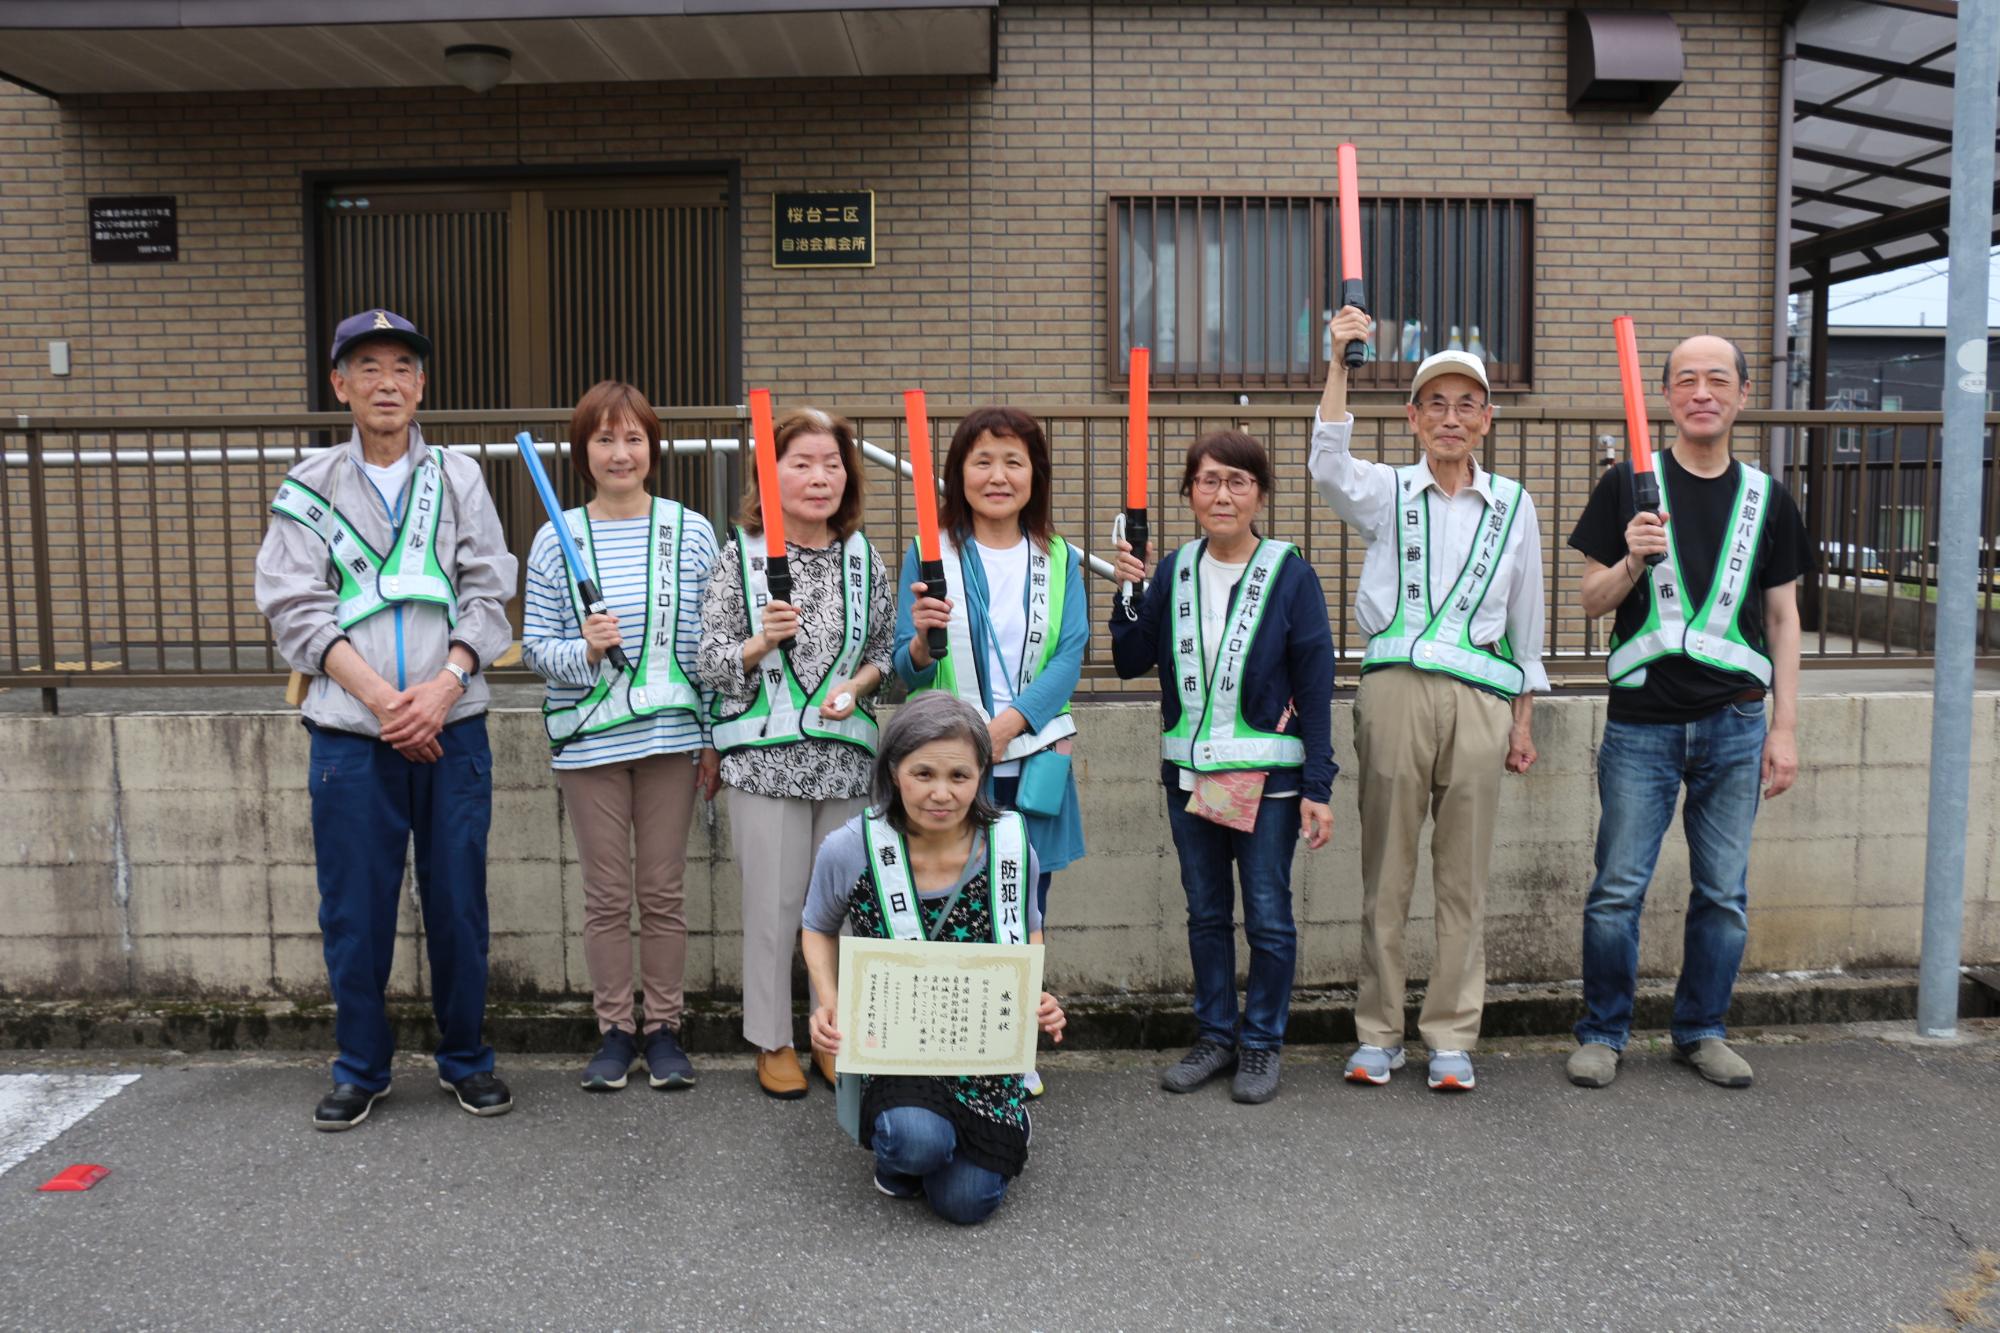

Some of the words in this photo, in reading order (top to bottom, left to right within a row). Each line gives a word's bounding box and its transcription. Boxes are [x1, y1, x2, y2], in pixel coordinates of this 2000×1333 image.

[782, 236, 865, 251] 自治会集会所
[787, 206, 859, 223] 桜台二区
[655, 525, 674, 647] 防犯パトロール
[1456, 499, 1509, 612] 防犯パトロール
[1718, 488, 1761, 607] 防犯パトロール
[836, 555, 862, 678] 防犯パトロール
[1022, 555, 1046, 685] 防犯パトロール
[1179, 566, 1197, 693] 春日部市
[1220, 566, 1267, 691] 防犯パトロール
[879, 846, 918, 940] 春日
[998, 989, 1013, 1032] 感謝状
